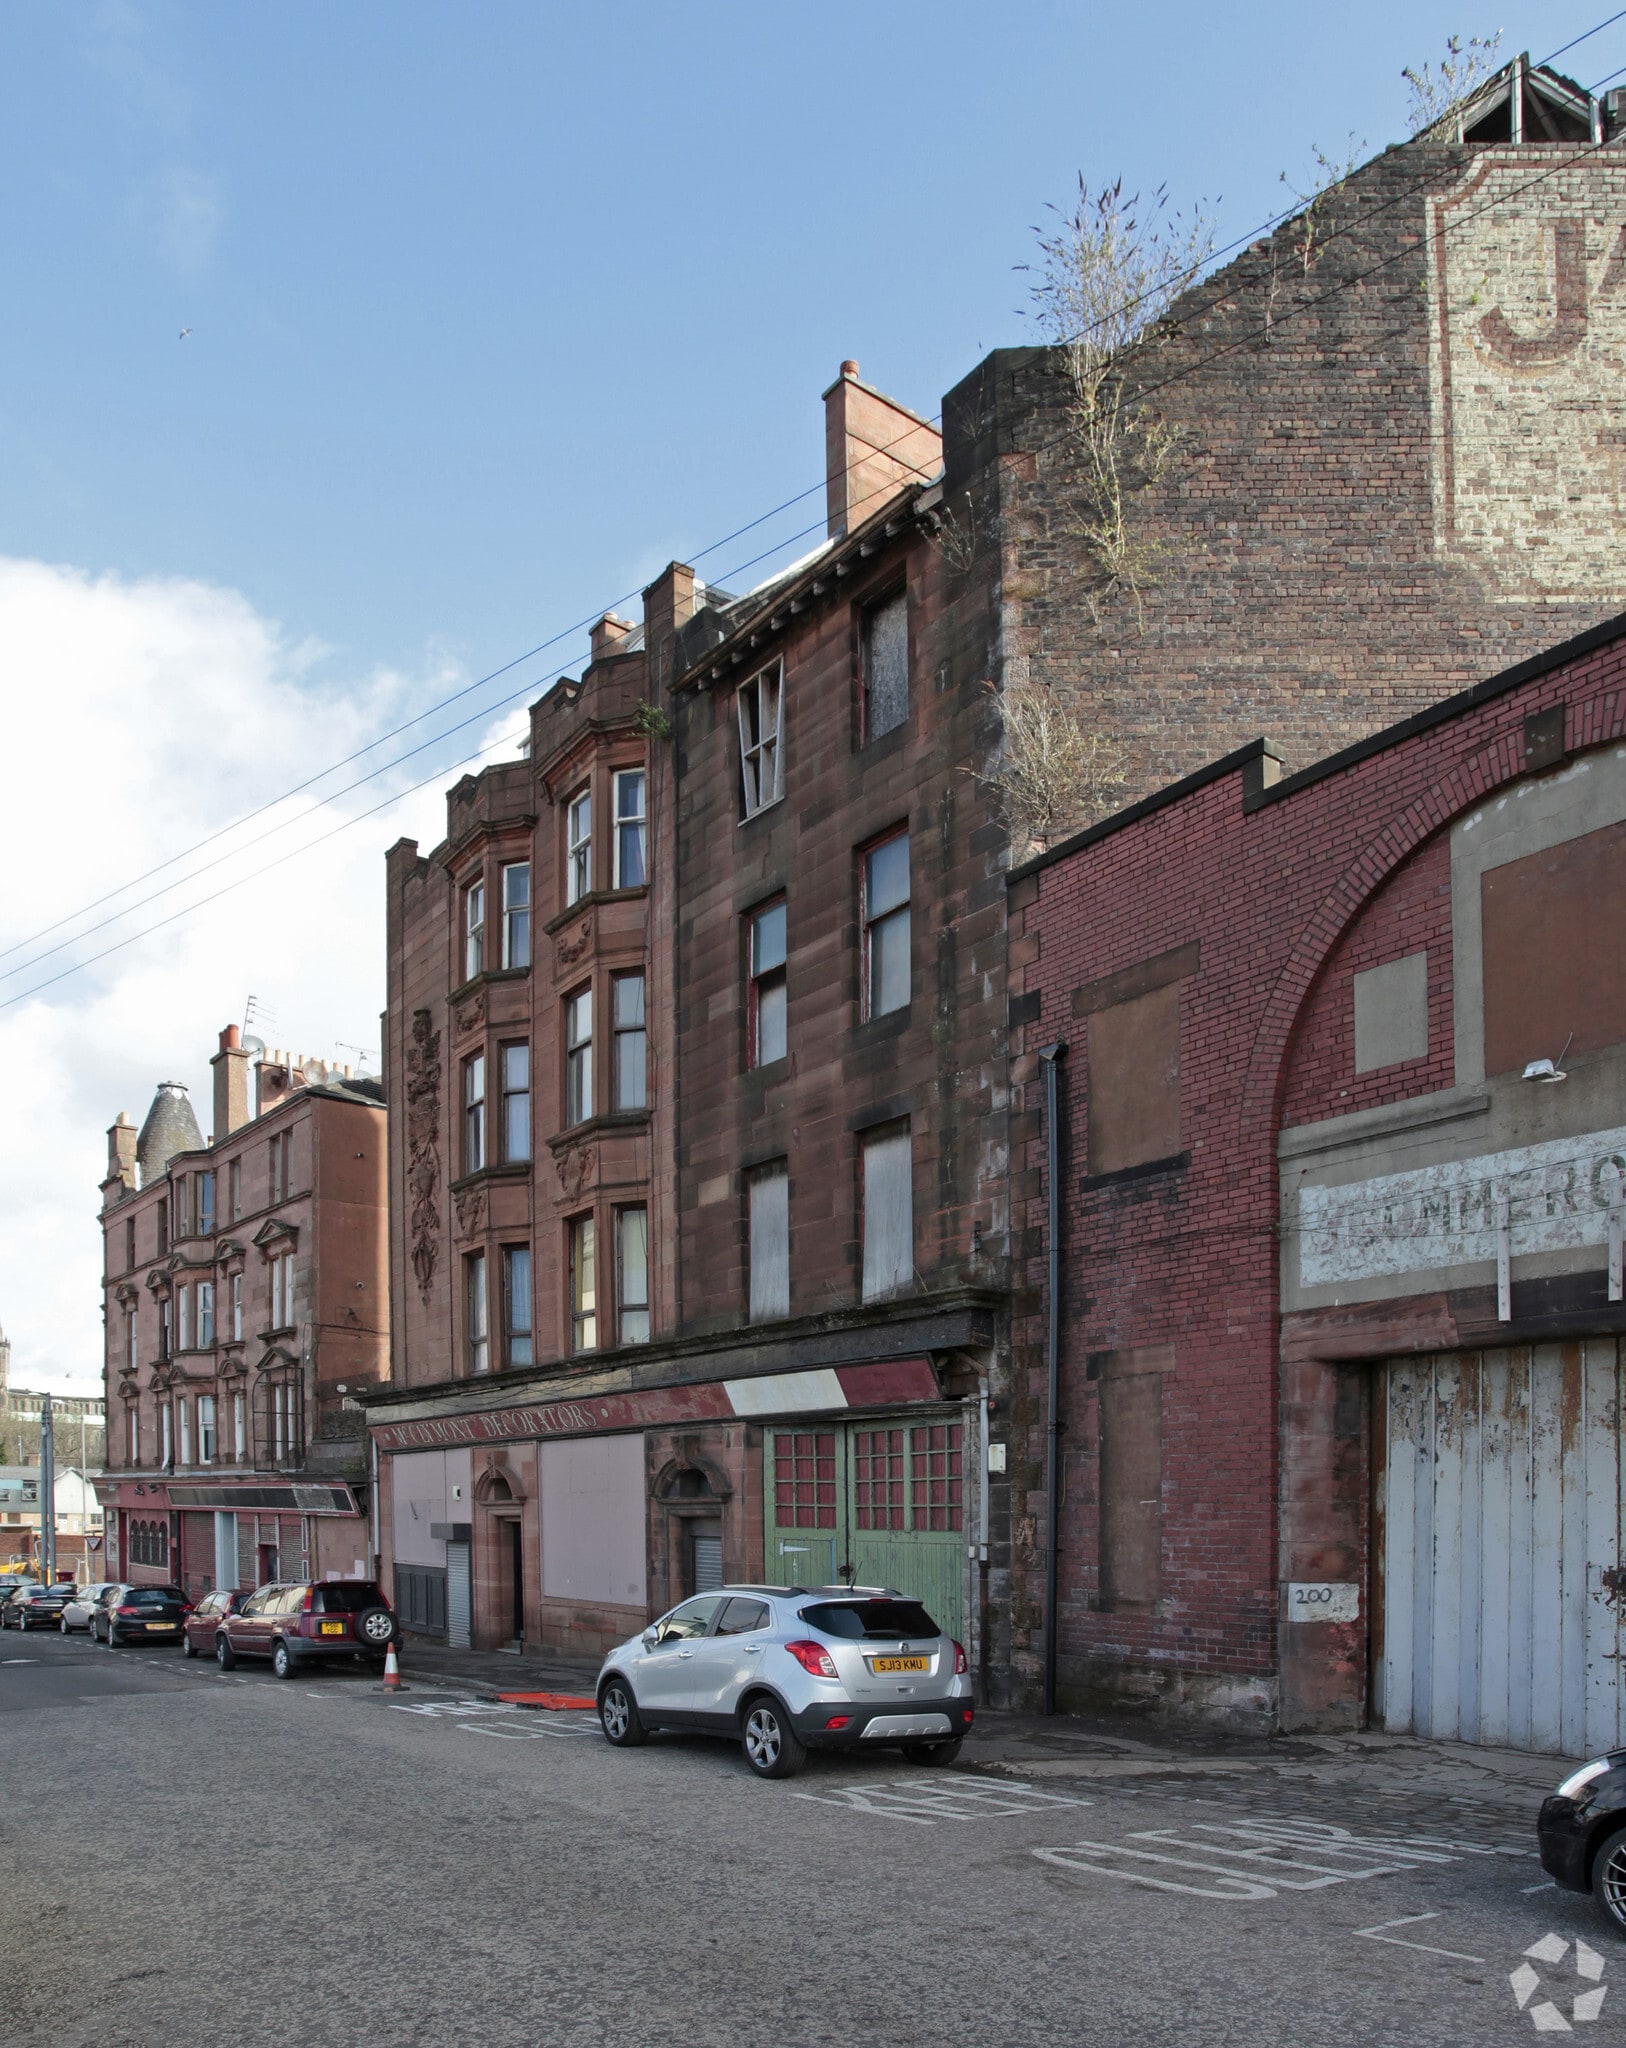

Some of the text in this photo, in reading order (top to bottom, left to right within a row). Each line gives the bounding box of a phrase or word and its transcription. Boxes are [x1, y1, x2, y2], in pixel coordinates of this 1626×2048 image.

[480, 1404, 597, 1438] DECORATORS
[1296, 1588, 1332, 1604] 200
[880, 1659, 923, 1671] SJ13 KMU
[456, 1716, 605, 1739] CLE
[788, 1776, 1095, 1825] KEEP
[1031, 1818, 1496, 1901] CLEAR
